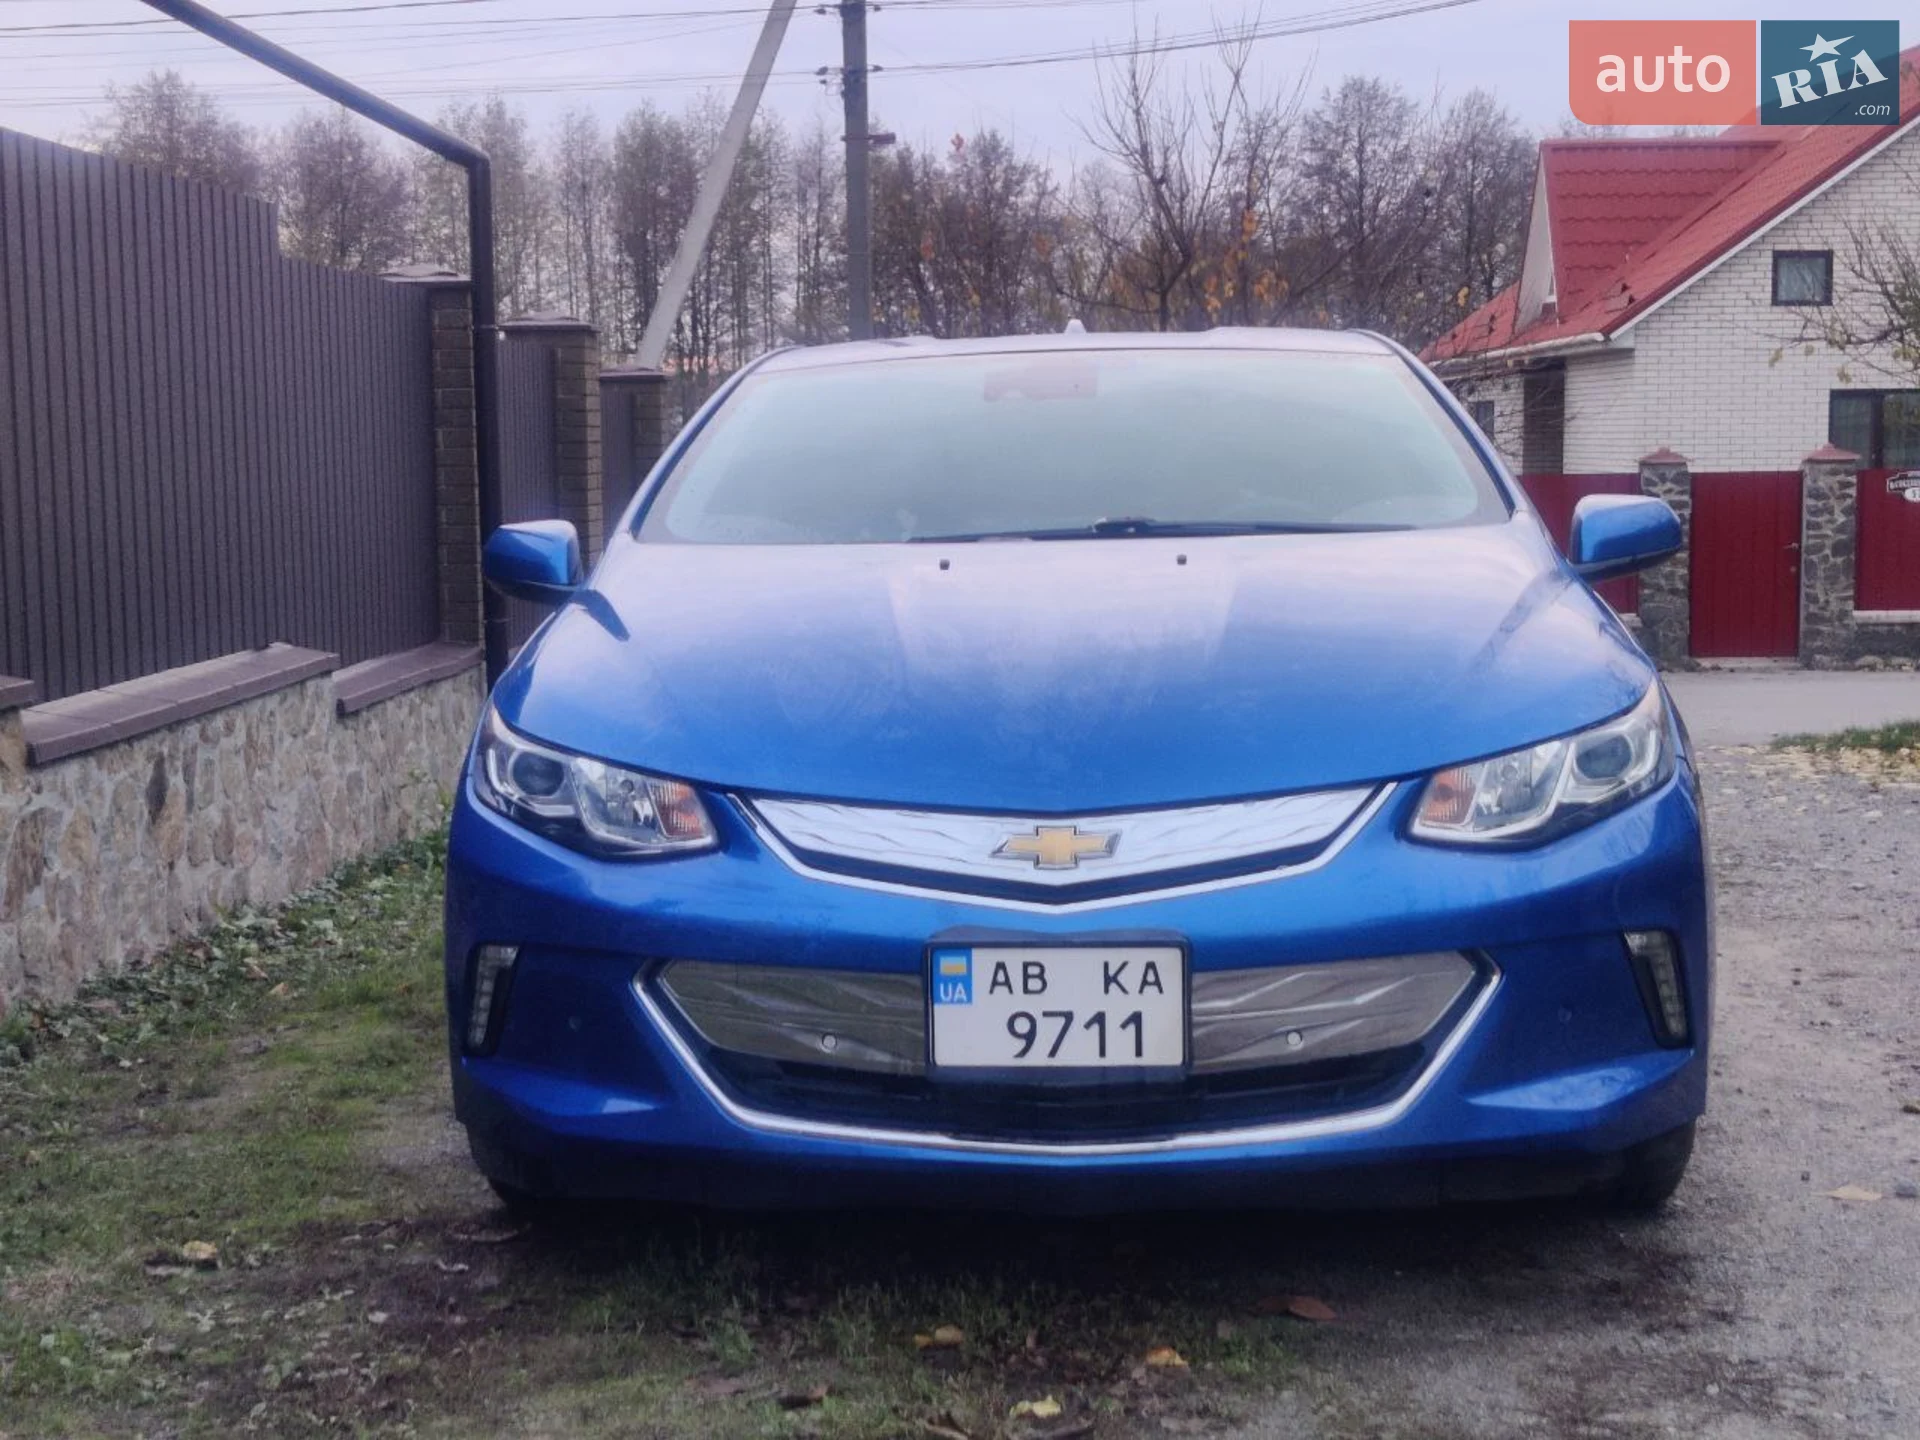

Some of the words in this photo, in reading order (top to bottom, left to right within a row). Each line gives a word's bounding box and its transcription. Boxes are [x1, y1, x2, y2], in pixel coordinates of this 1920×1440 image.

[940, 983, 967, 1002] UA
[989, 961, 1048, 995] AB
[1103, 961, 1164, 995] KA
[1006, 1010, 1143, 1058] 9711
